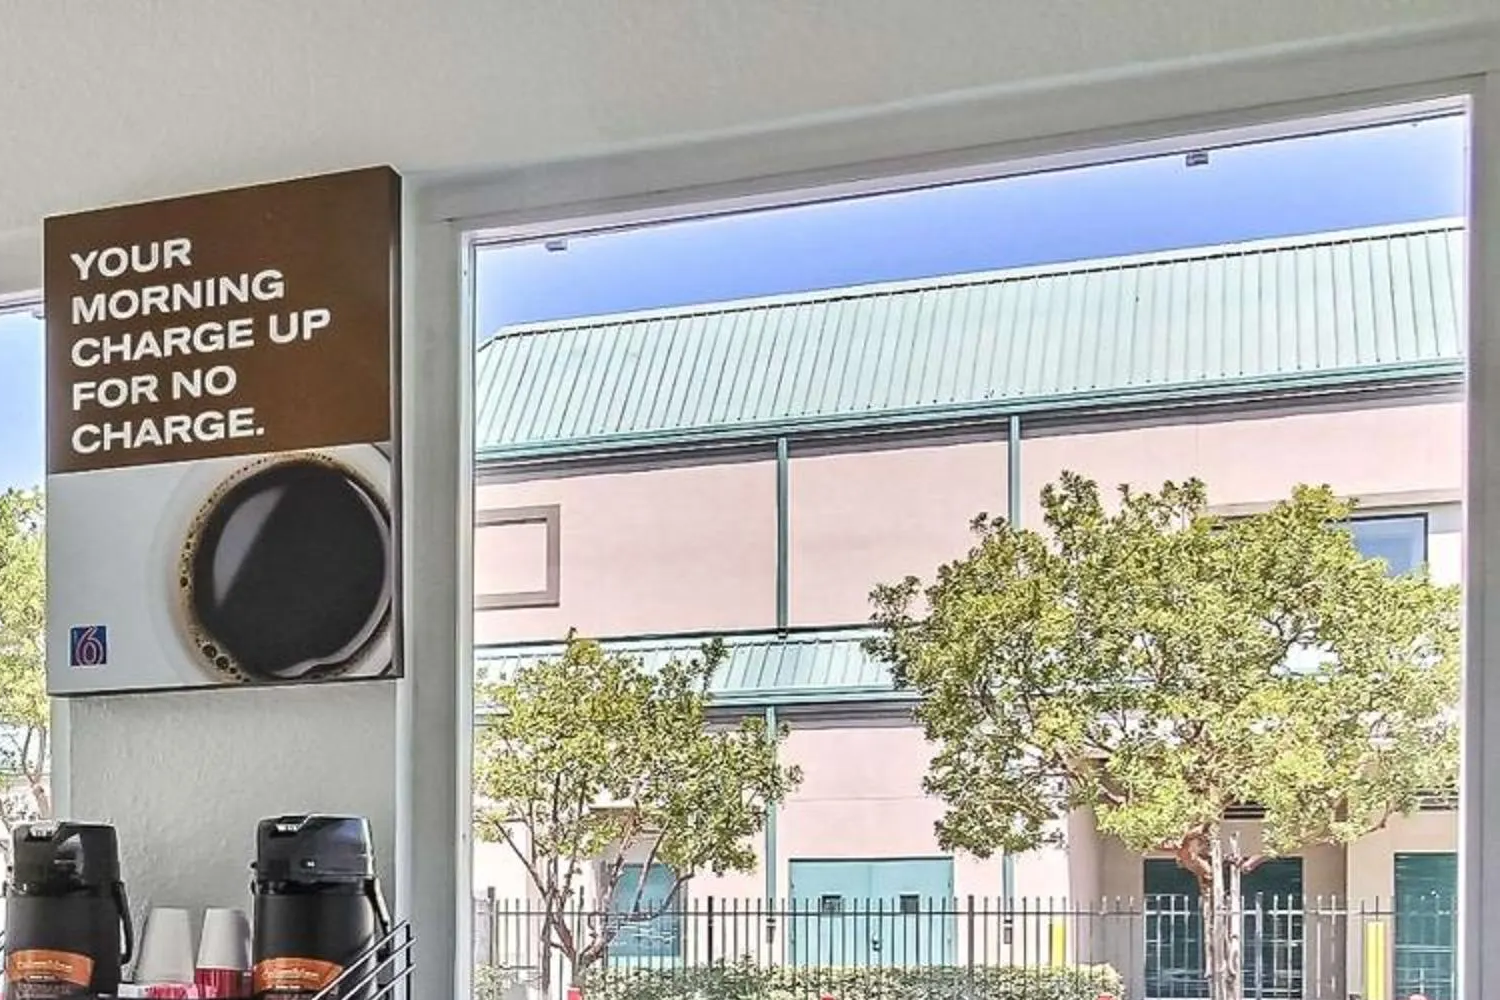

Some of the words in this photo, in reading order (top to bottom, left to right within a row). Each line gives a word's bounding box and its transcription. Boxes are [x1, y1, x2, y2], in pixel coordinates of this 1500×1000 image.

[70, 237, 192, 280] YOUR
[71, 269, 285, 325] MORNING
[71, 318, 255, 367] CHARGE
[268, 308, 331, 344] UP
[72, 374, 159, 411] FOR
[171, 365, 237, 400] NO
[71, 407, 265, 454] CHARGE.
[75, 625, 105, 669] 6
